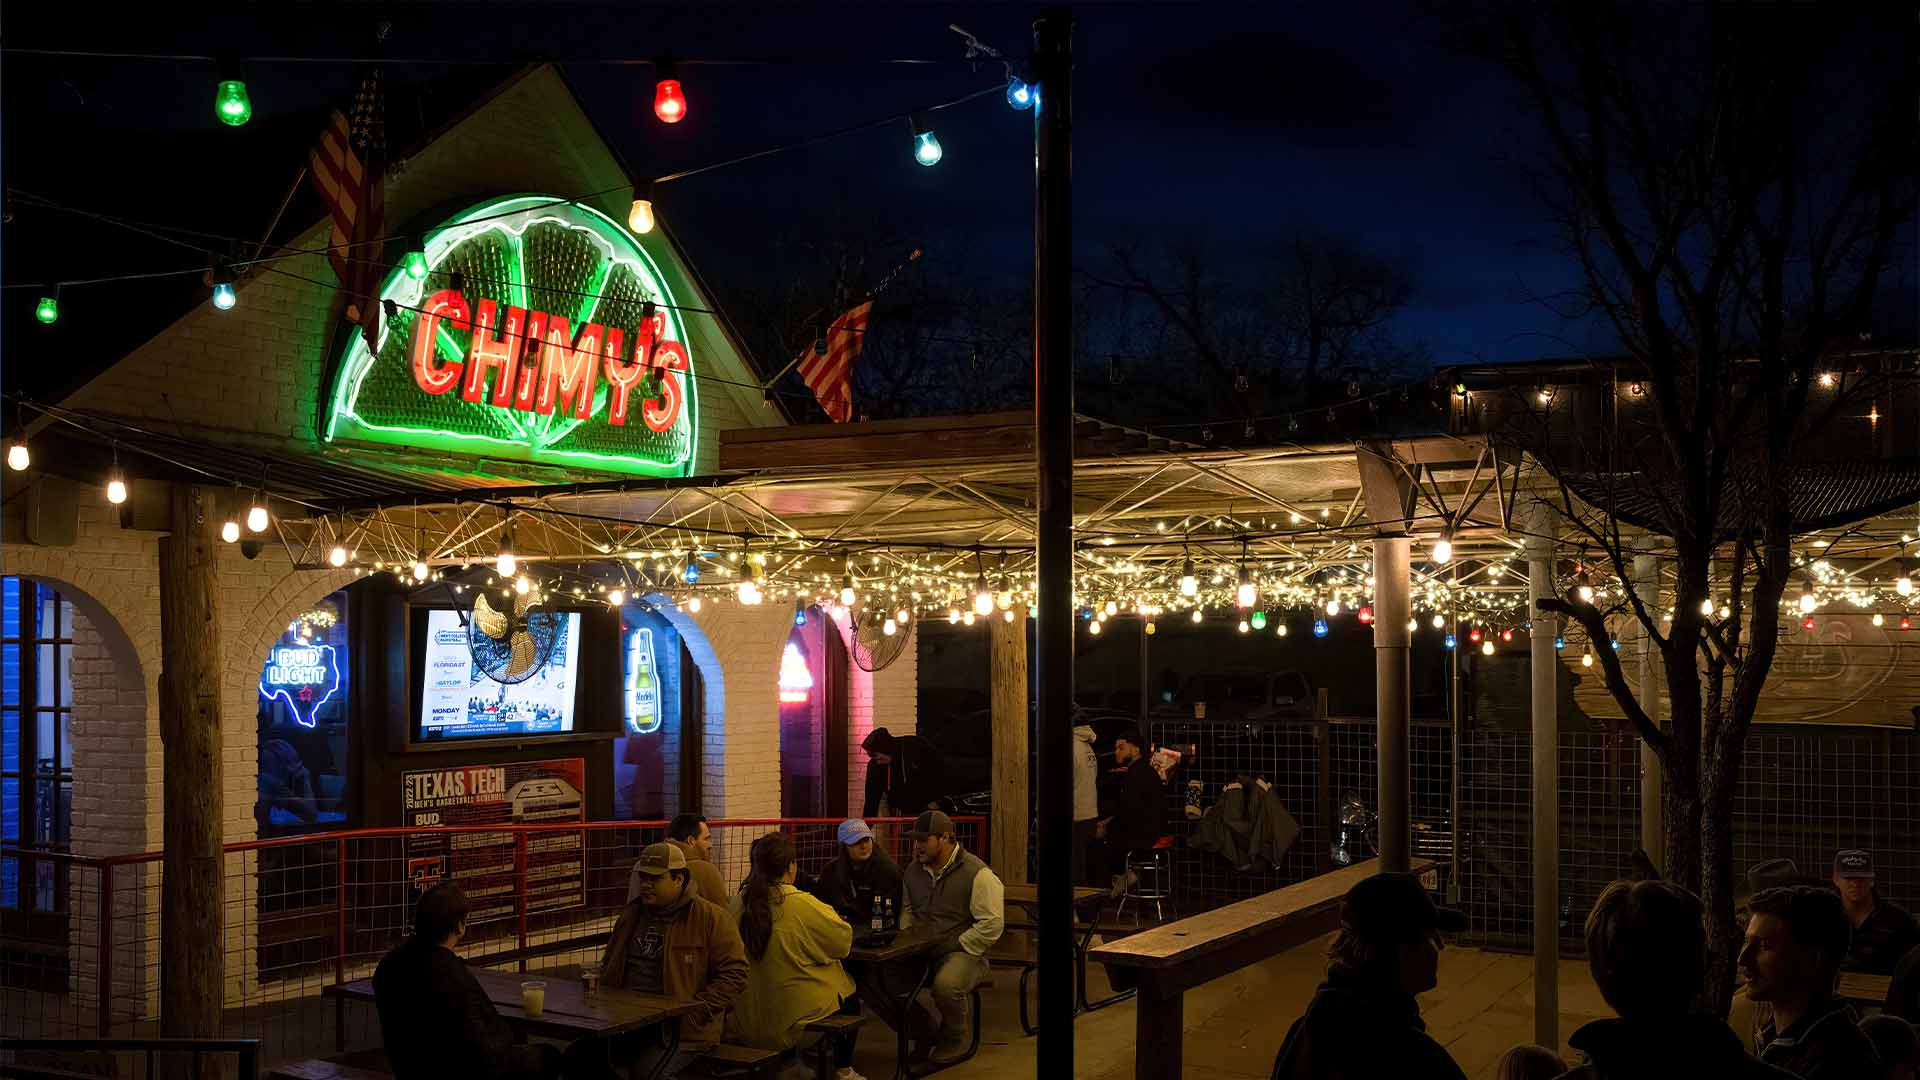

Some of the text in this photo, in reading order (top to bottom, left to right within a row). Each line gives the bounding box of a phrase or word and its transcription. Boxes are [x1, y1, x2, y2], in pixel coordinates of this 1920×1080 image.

[413, 289, 688, 433] CHIMY'S
[277, 649, 320, 666] BUD
[269, 666, 326, 684] LIGHT
[414, 767, 505, 800] TEXAS TECH
[414, 799, 434, 809] MEN'S
[415, 813, 440, 826] BUD
